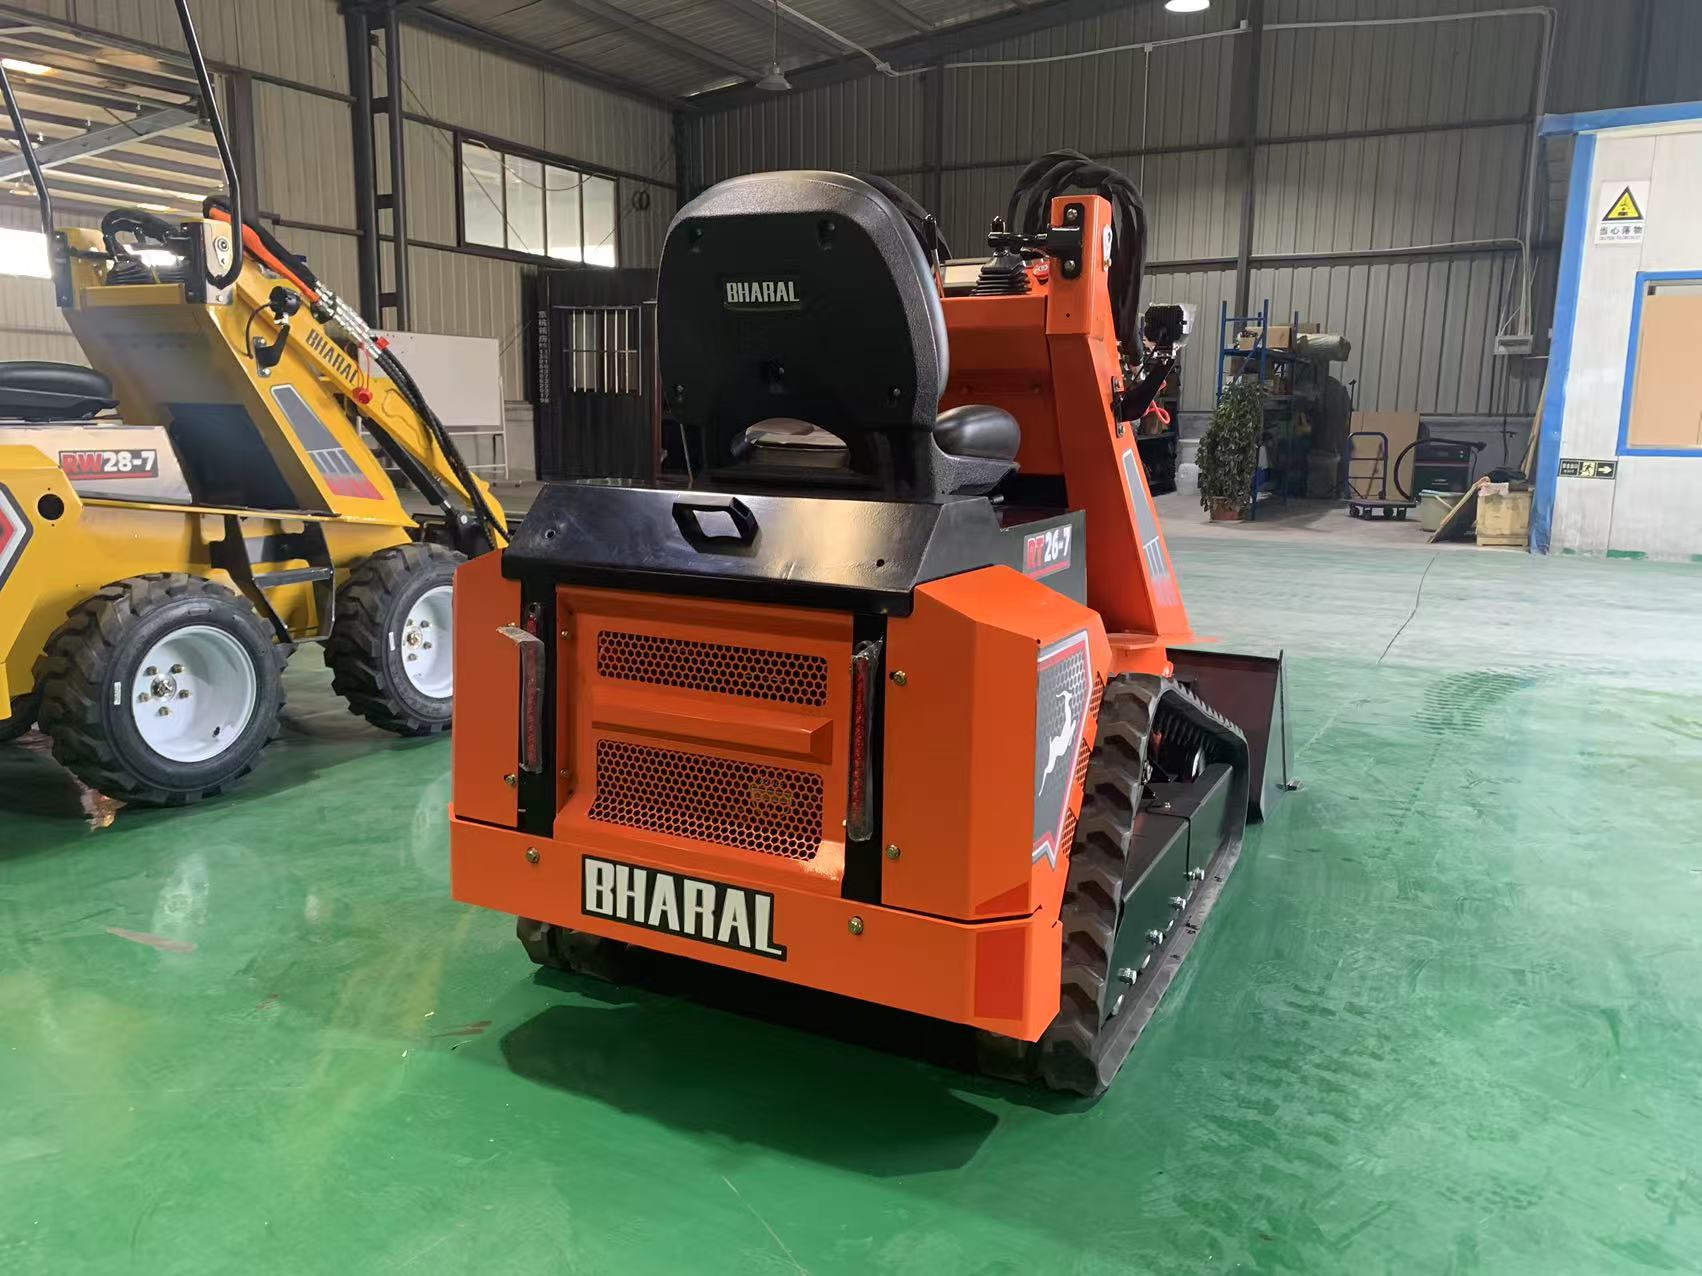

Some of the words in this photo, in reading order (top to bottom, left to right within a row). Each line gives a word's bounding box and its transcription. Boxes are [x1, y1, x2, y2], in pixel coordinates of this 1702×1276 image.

[726, 281, 800, 303] BHARAL
[60, 450, 155, 473] RW28-7
[1027, 524, 1072, 569] RT26-7
[584, 858, 783, 956] BHARAL
